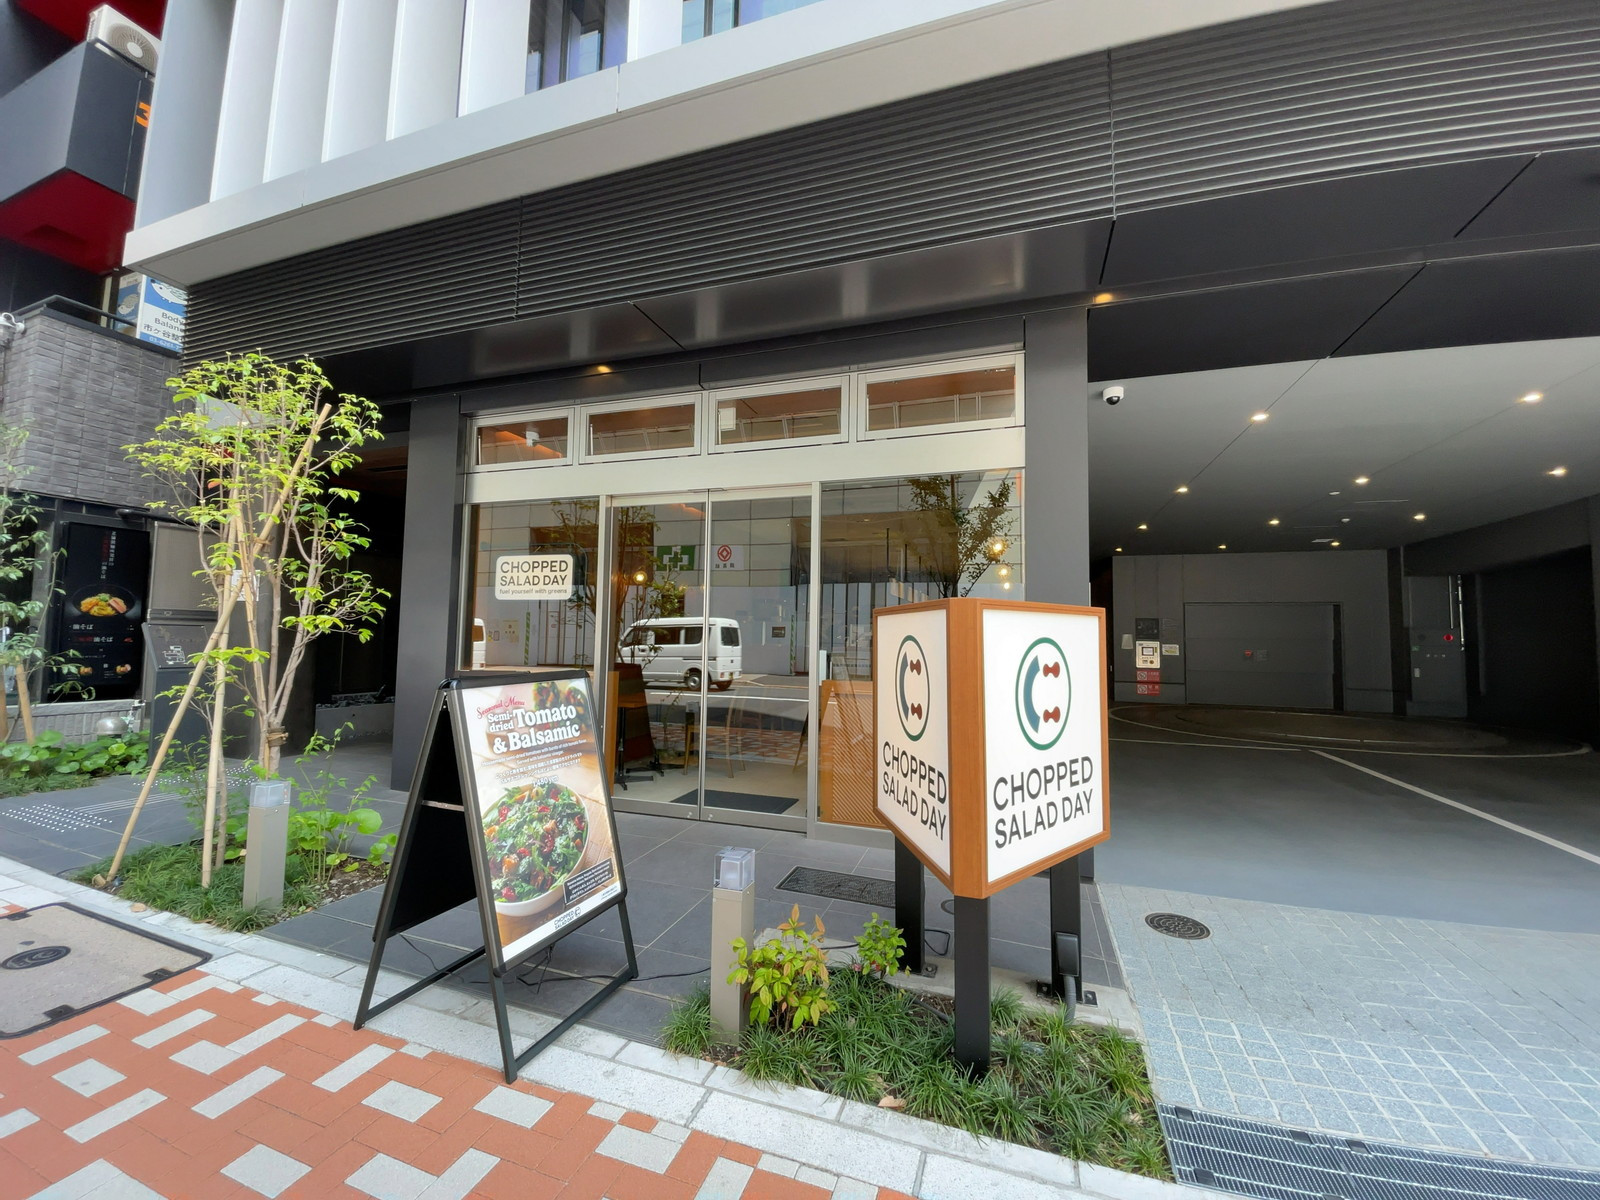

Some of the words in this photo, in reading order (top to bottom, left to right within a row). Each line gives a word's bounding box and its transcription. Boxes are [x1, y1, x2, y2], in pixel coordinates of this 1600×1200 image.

[161, 312, 184, 325] Body
[500, 560, 569, 573] CHOPPED
[500, 575, 540, 586] SALAD
[543, 574, 568, 586] DAY
[476, 700, 503, 719] Seasonal
[504, 696, 525, 707] Menu
[487, 711, 513, 723] Semi-
[513, 705, 577, 728] Tomato
[489, 720, 514, 732] dried
[493, 737, 508, 755] &
[508, 723, 581, 751] Balsamic
[883, 741, 947, 805] CHOPPED
[993, 755, 1094, 811] CHOPPED
[883, 771, 919, 817] SALAD
[920, 800, 947, 841] DAY
[994, 801, 1058, 849] SALAD
[1062, 788, 1094, 822] DAY
